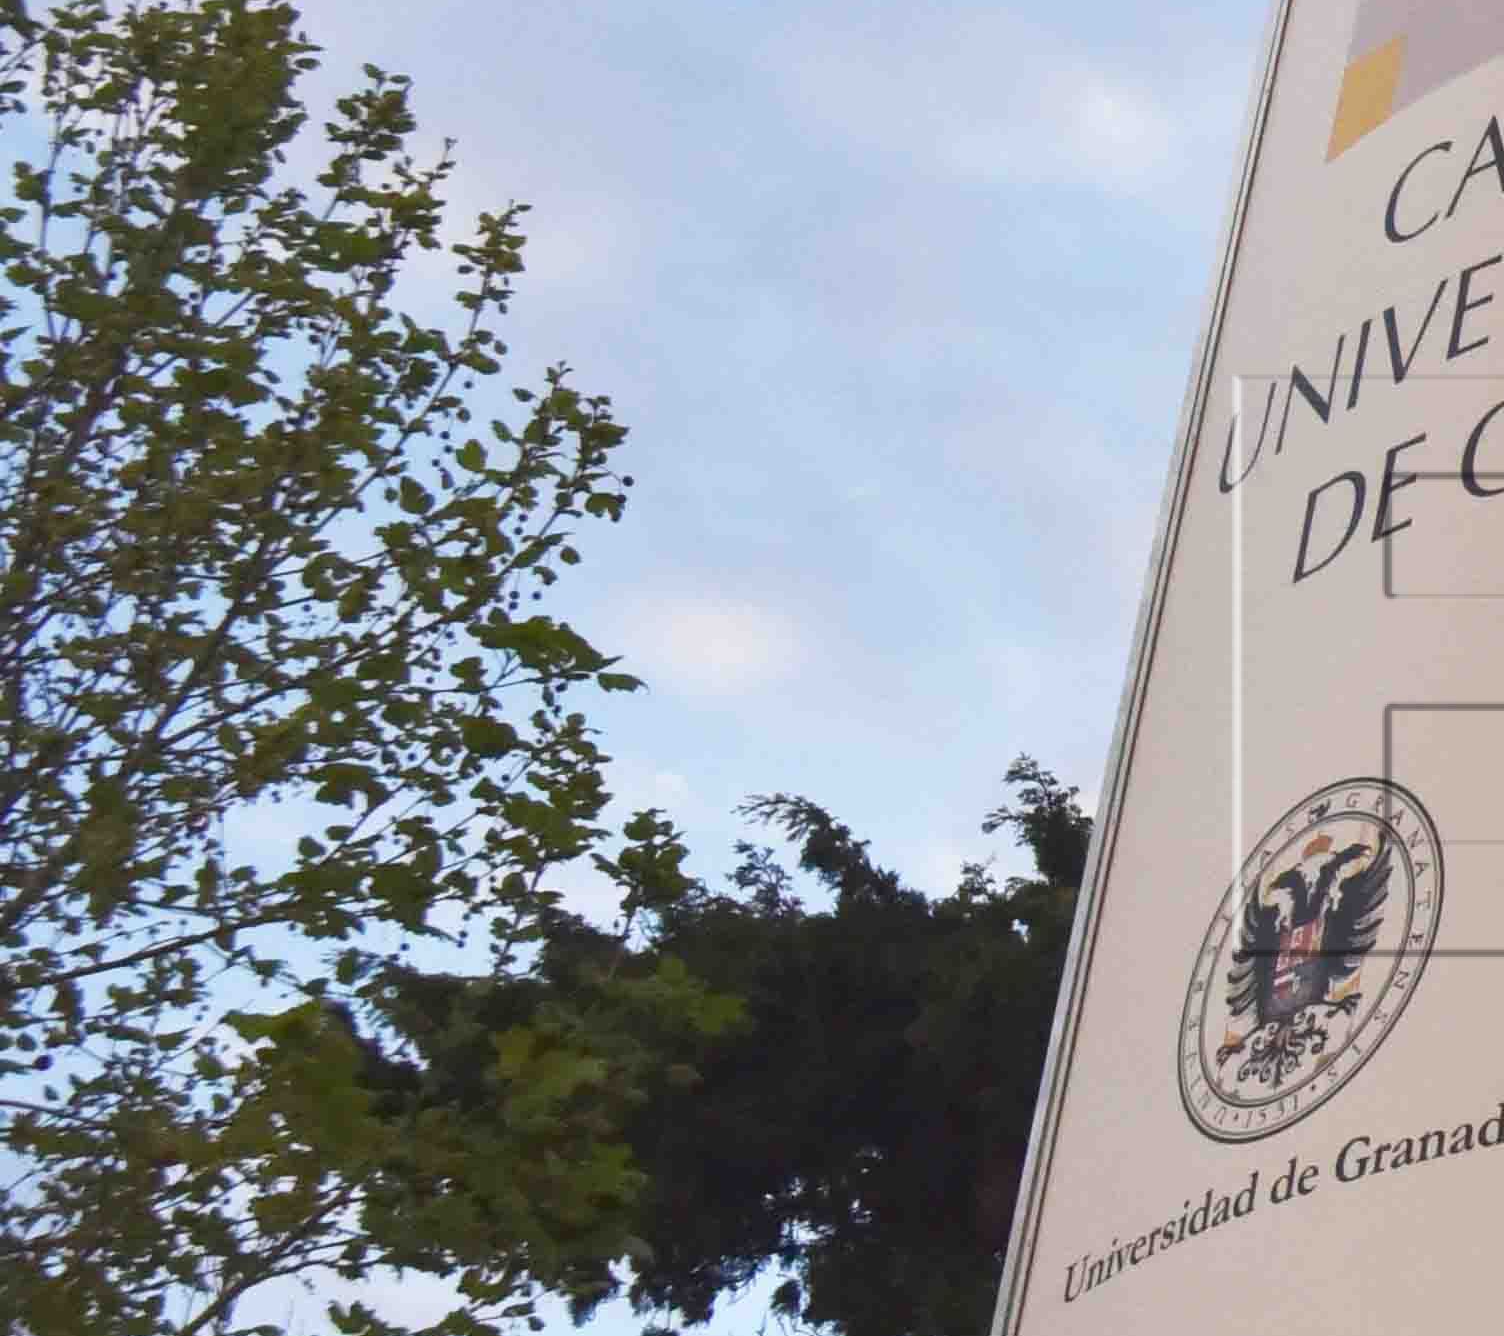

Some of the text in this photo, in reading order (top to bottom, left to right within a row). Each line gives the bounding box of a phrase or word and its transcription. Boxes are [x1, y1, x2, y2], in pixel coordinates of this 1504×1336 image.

[1292, 432, 1428, 584] DE
[1064, 1171, 1260, 1303] Universidad
[1270, 1155, 1320, 1203] de
